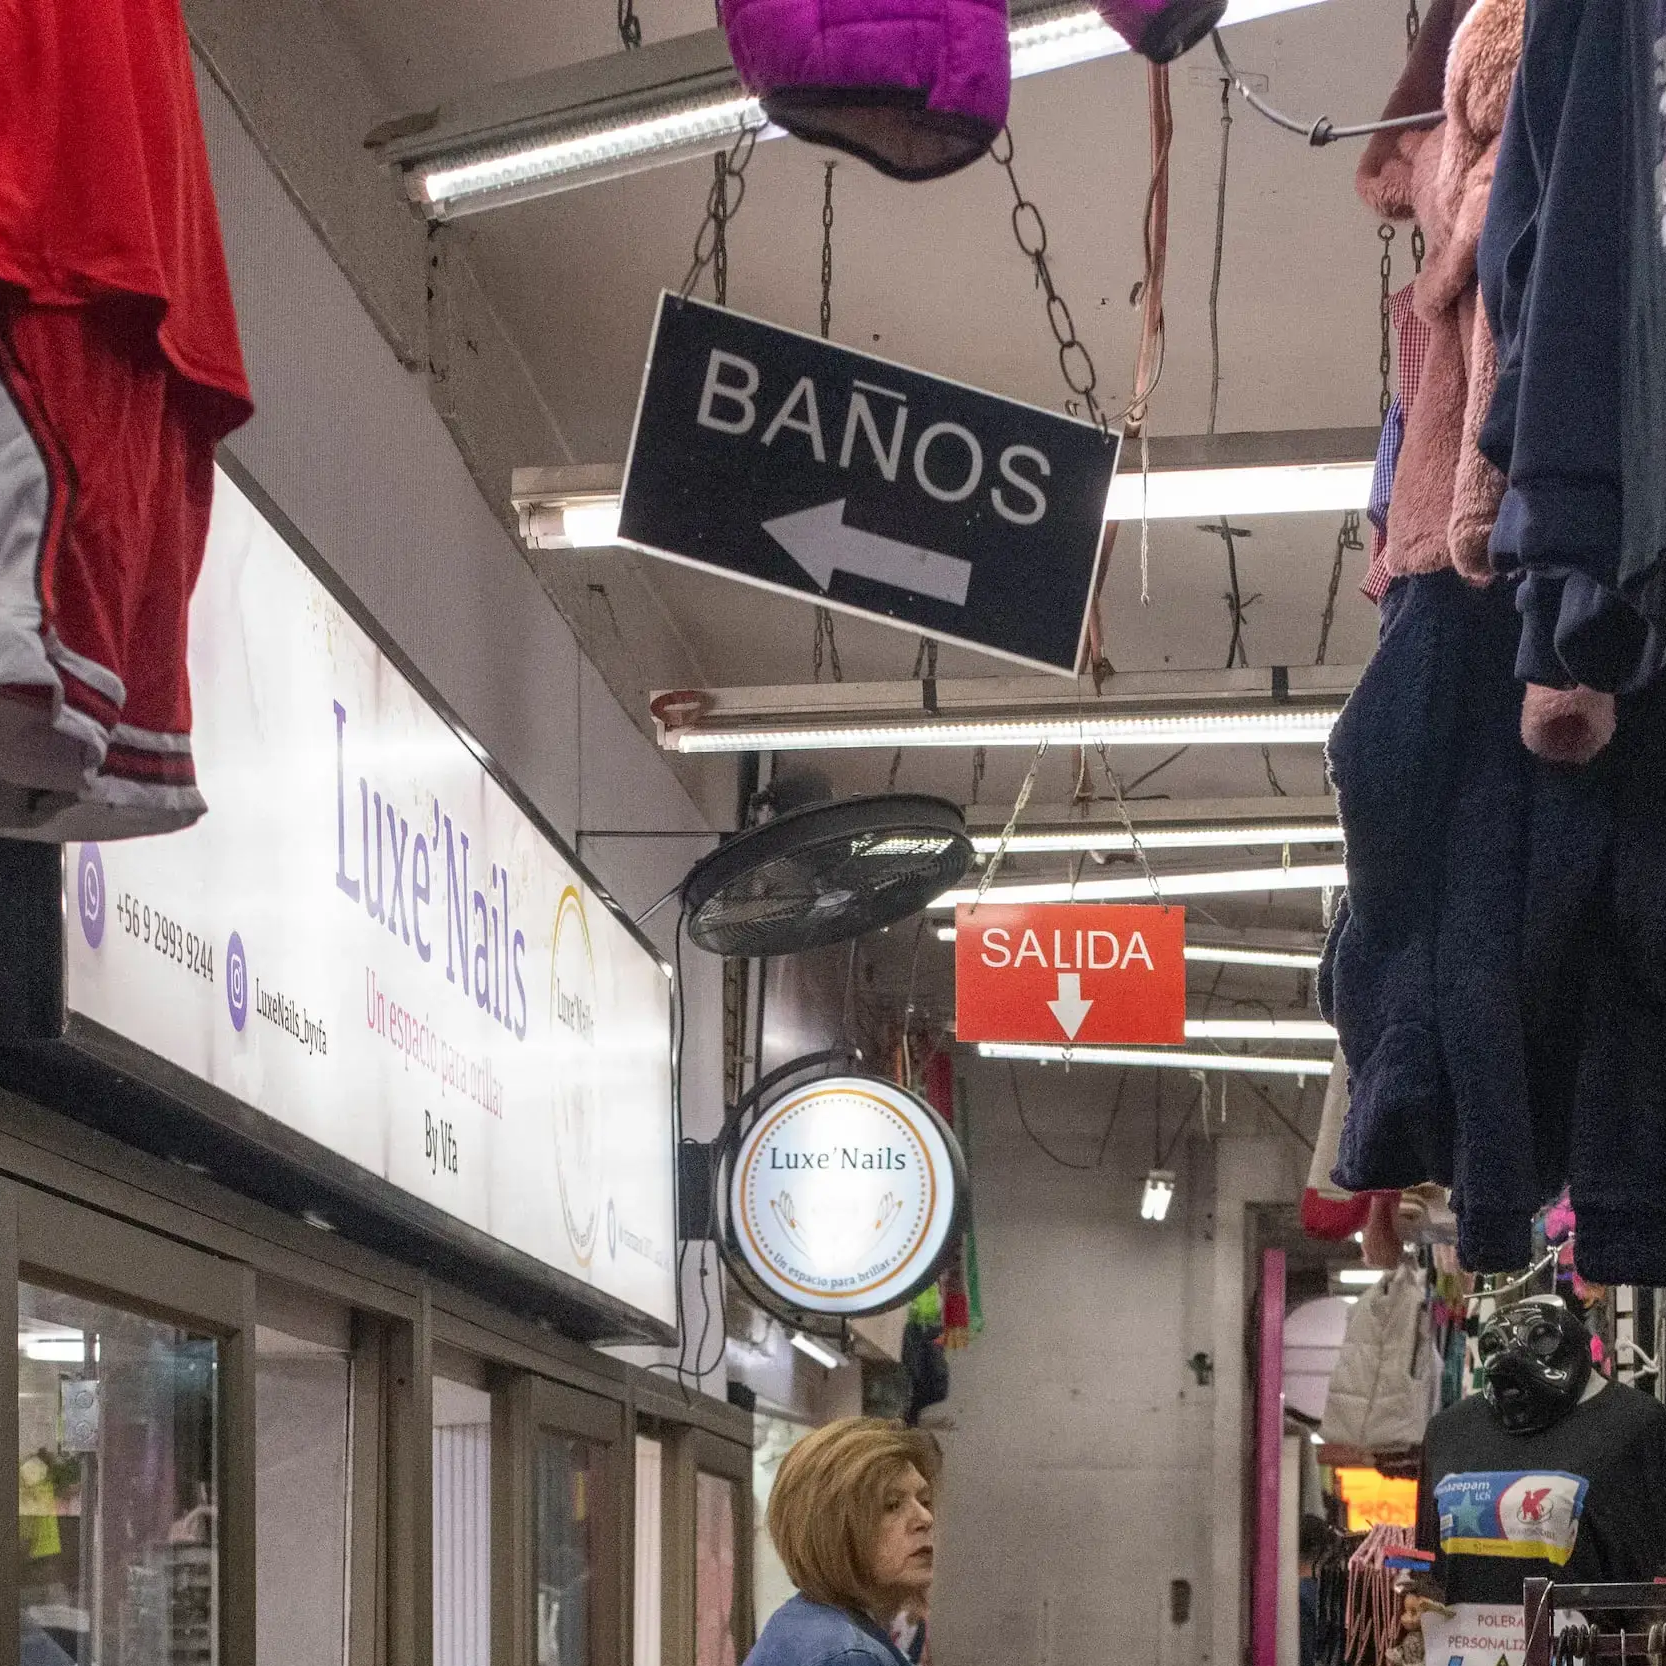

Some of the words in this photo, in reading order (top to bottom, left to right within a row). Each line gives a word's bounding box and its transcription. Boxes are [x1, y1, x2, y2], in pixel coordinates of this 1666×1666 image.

[696, 348, 1052, 526] BAÑOS
[333, 698, 528, 1042] Luxe'Nails
[116, 892, 141, 938] +56
[143, 906, 152, 943] 9
[154, 911, 184, 964] 2993
[185, 931, 214, 982] 9244
[980, 927, 1155, 971] SALIDA
[255, 977, 328, 1056] LuxeNails_byvfa
[365, 966, 386, 1038] Un
[389, 1001, 438, 1072] espacio
[440, 1038, 467, 1097] para
[424, 1109, 439, 1176] By
[439, 1118, 459, 1174] Vfa
[770, 1146, 907, 1171] Luxe'Nails
[773, 1252, 789, 1271] Un
[788, 1265, 829, 1288] espacio
[830, 1275, 857, 1290] para
[858, 1257, 893, 1284] brillar
[1448, 1636, 1526, 1650] PERSONALIZ
[1477, 1613, 1525, 1629] POLERA
